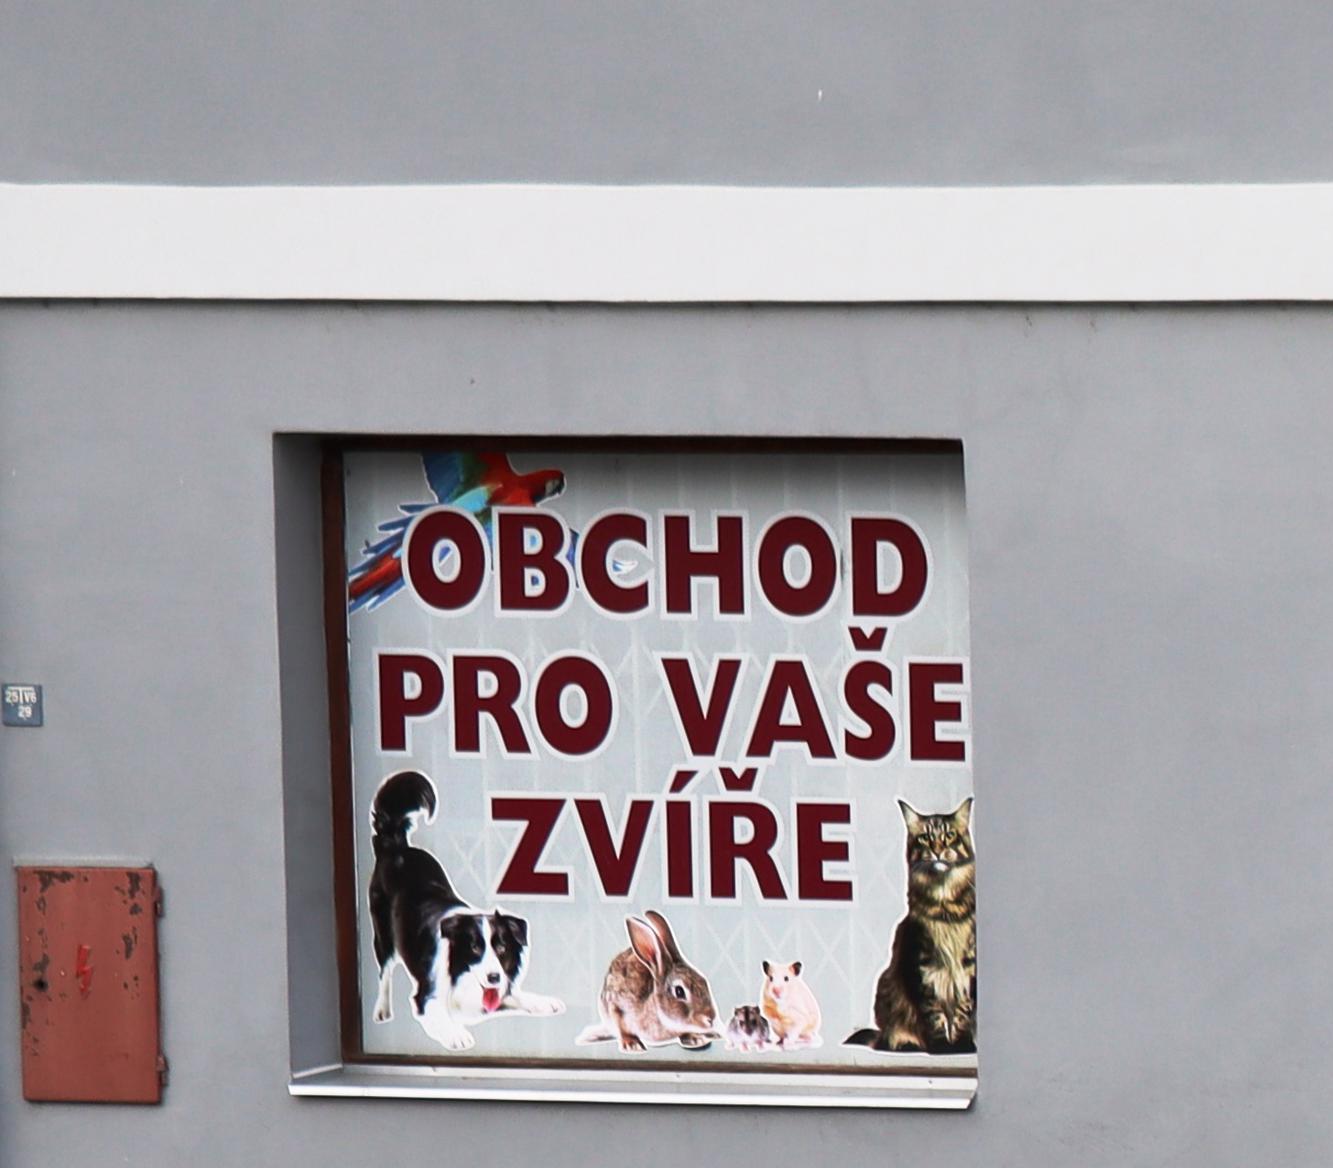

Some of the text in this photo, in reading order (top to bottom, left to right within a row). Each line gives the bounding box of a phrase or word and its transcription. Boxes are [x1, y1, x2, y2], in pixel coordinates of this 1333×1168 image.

[406, 511, 929, 618] OBCHOD
[376, 625, 966, 763] PRO VAŠE
[490, 766, 855, 901] ZVÍŘE
